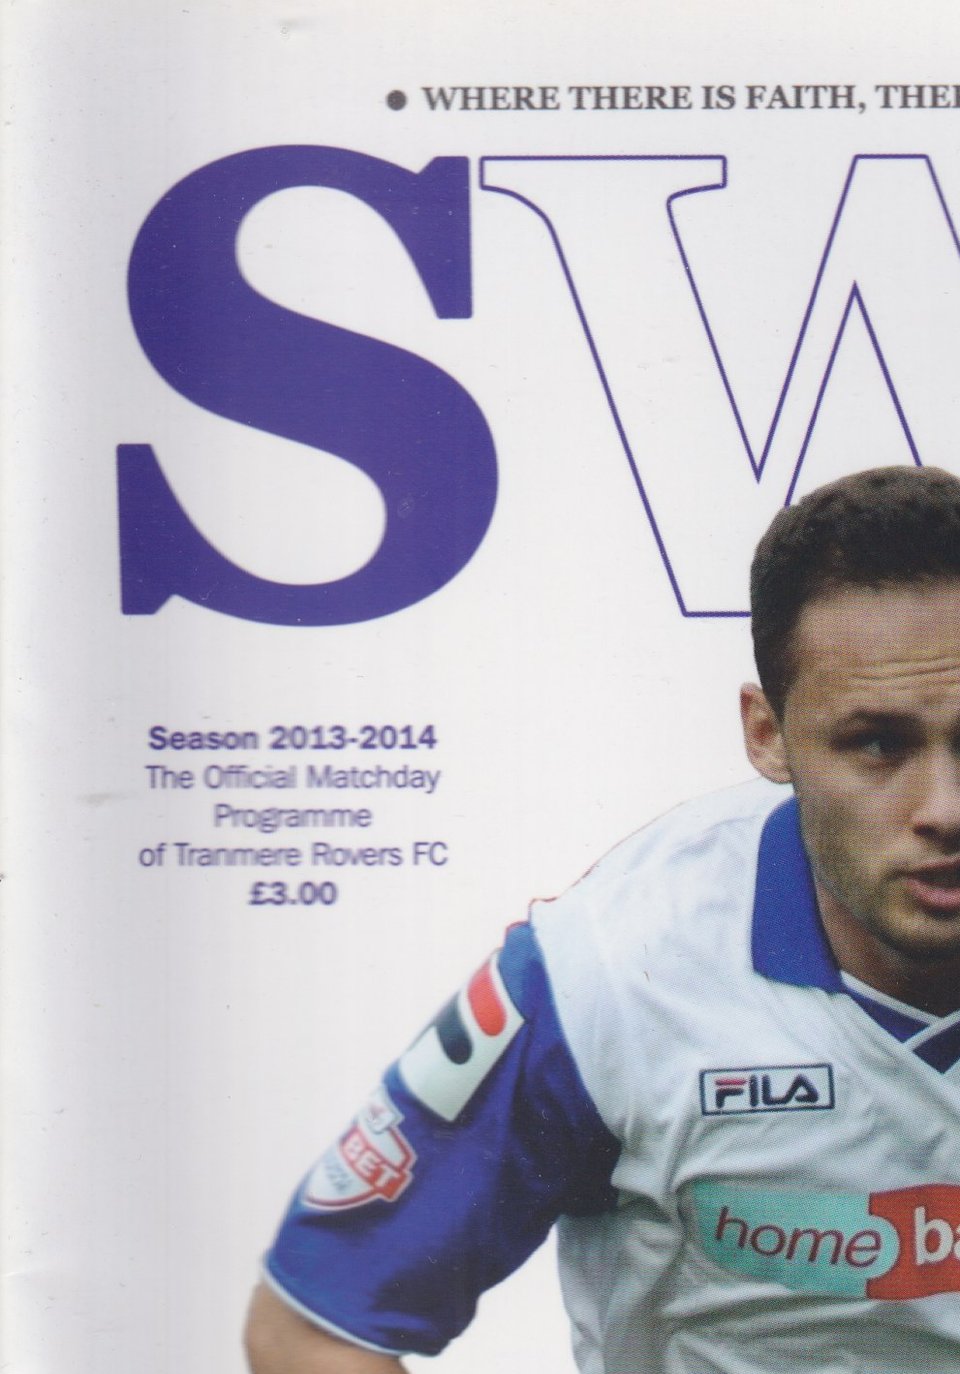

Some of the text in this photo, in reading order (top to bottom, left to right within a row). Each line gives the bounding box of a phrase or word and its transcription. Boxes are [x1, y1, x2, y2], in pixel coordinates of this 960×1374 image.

[422, 86, 560, 111] WHERE
[568, 86, 691, 110] THERE
[701, 86, 736, 110] IS
[745, 85, 866, 113] FAITH,
[148, 725, 438, 750] Season 2013-2014
[145, 764, 441, 794] The Official Matchday
[213, 803, 372, 833] Programme
[139, 842, 448, 867] of Tranmere Rovers FC
[248, 881, 338, 906] £3.00
[714, 1073, 819, 1108] FILA
[714, 1207, 882, 1269] home
